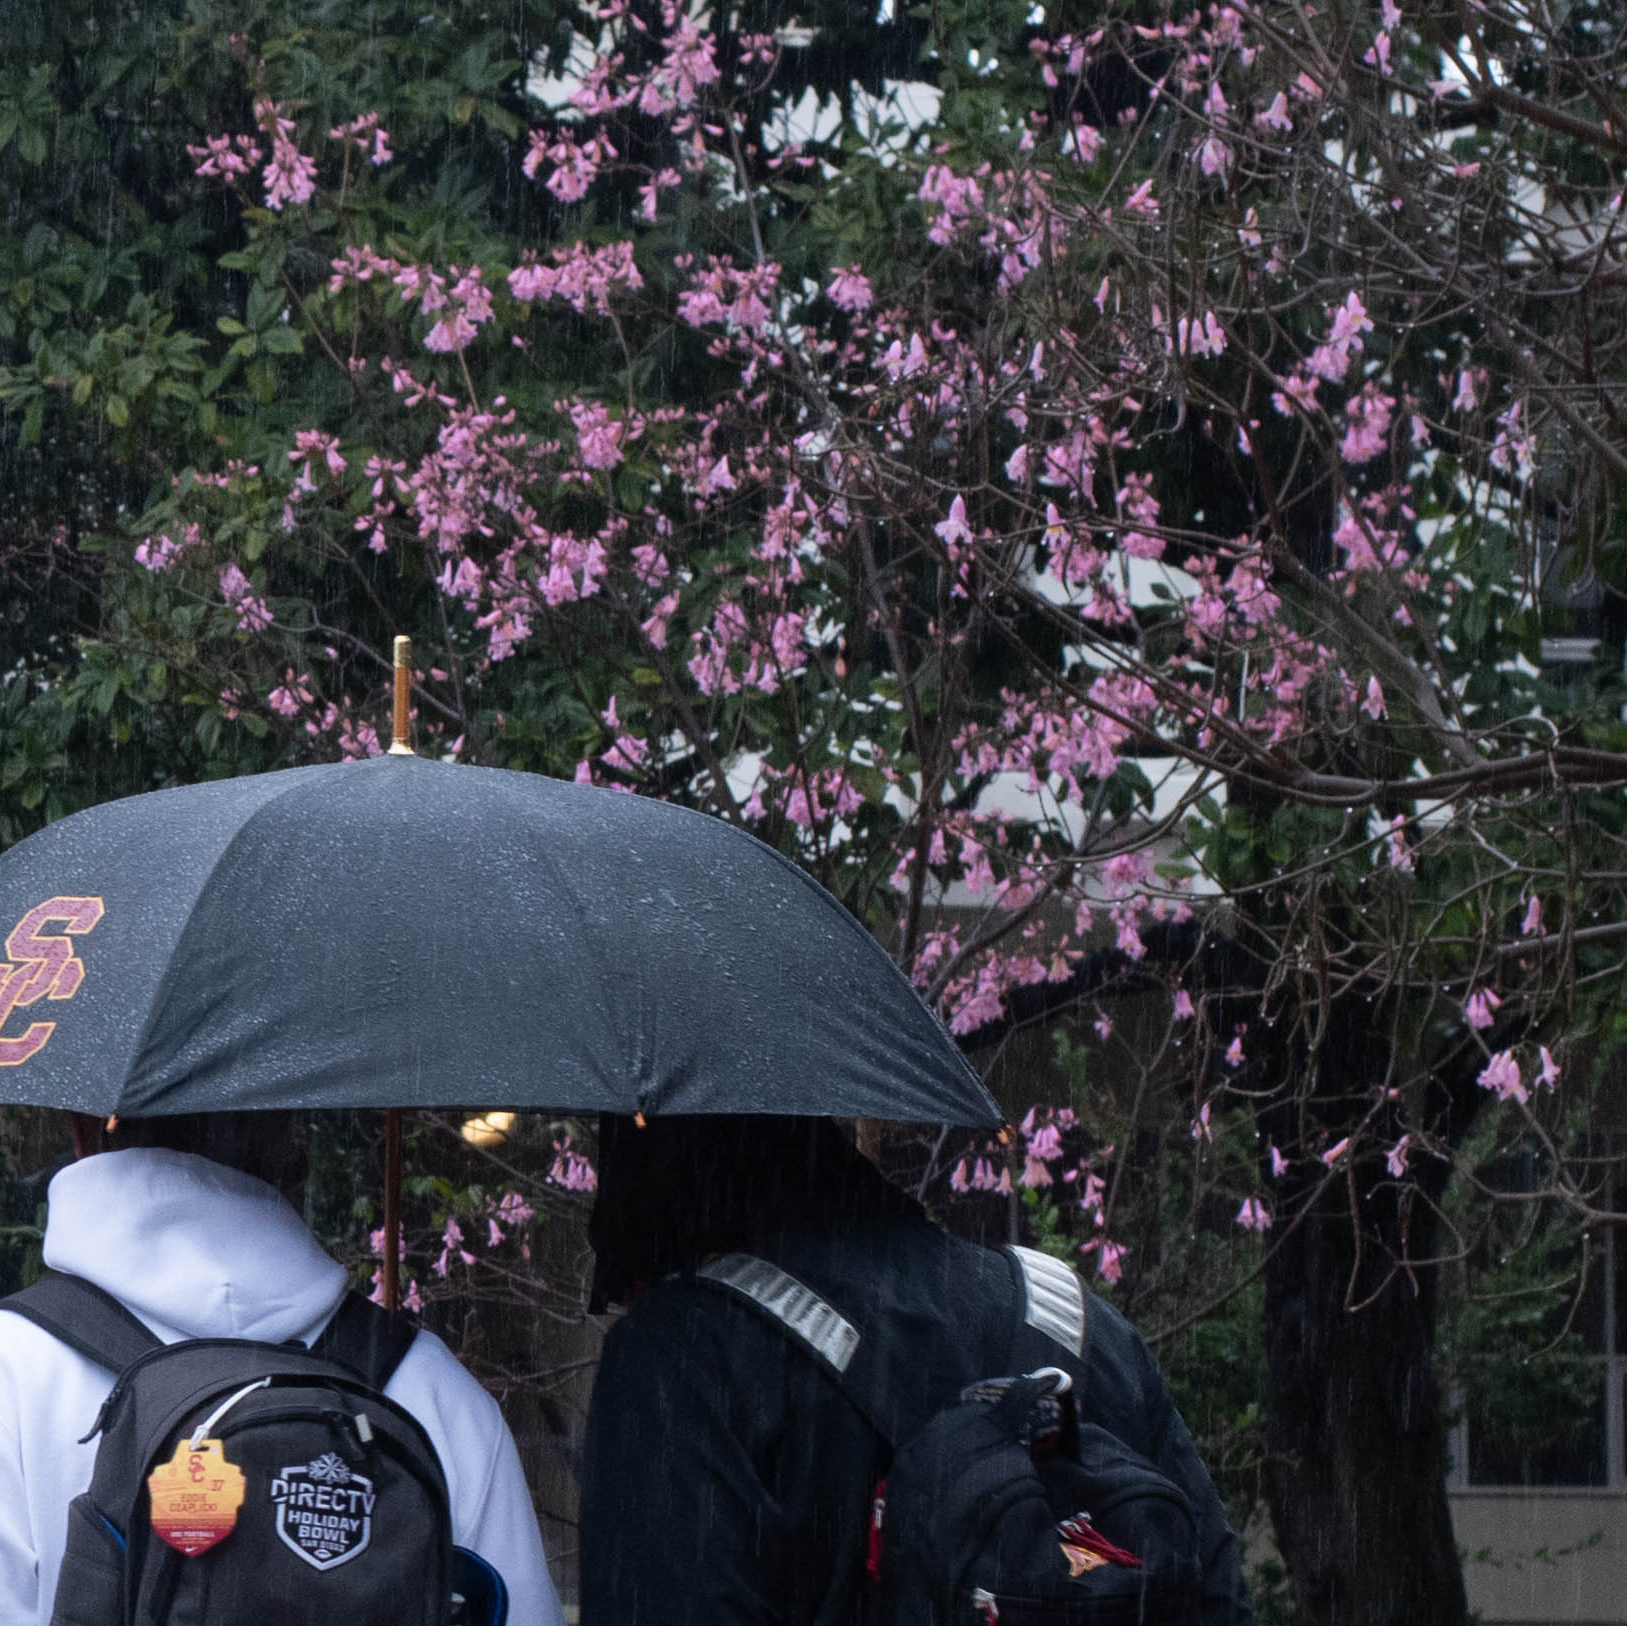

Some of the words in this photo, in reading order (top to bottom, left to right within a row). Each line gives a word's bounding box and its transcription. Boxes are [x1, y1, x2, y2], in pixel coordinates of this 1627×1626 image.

[270, 1479, 376, 1515] DIRECTV
[288, 1510, 360, 1532] HOLIDAY
[298, 1525, 349, 1545] BOWL
